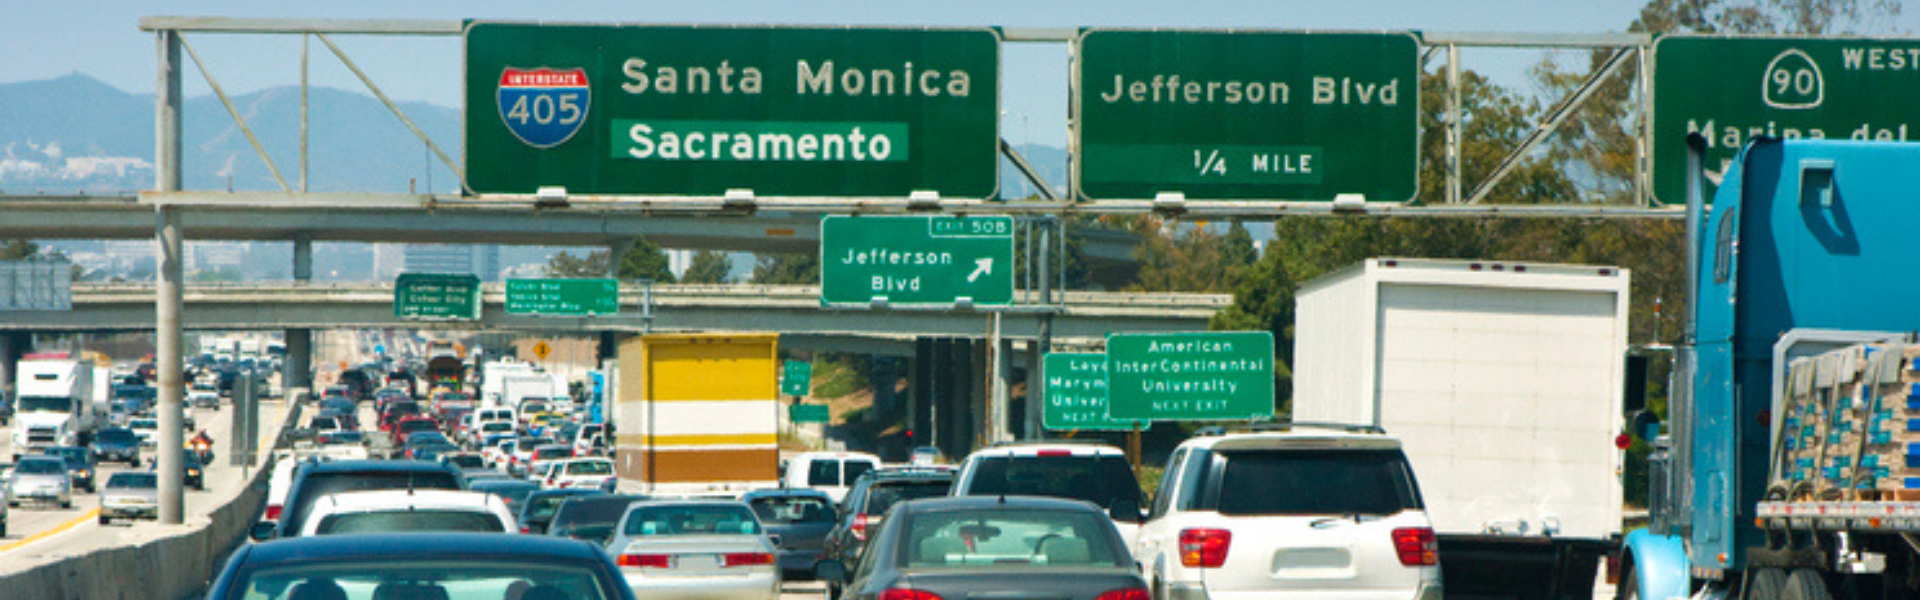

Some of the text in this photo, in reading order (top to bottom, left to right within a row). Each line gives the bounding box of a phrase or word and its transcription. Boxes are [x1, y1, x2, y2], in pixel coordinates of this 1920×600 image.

[1842, 47, 1920, 70] WEST
[507, 73, 577, 84] INTERSTATE
[621, 57, 971, 97] Santa Monica
[1773, 68, 1814, 95] 90
[1101, 74, 1398, 106] Jefferson Blvd
[507, 94, 581, 125] 405
[628, 123, 891, 161] Sacramento
[1194, 149, 1312, 176] 1/4 MILE
[935, 221, 1007, 234] EXIT 50B
[842, 249, 951, 265] Jefferson
[871, 275, 920, 292] Blvd
[1148, 340, 1232, 353] American
[1116, 358, 1263, 373] InterContinental
[1142, 379, 1237, 393] University
[1153, 400, 1228, 411] NEXT EXIT
